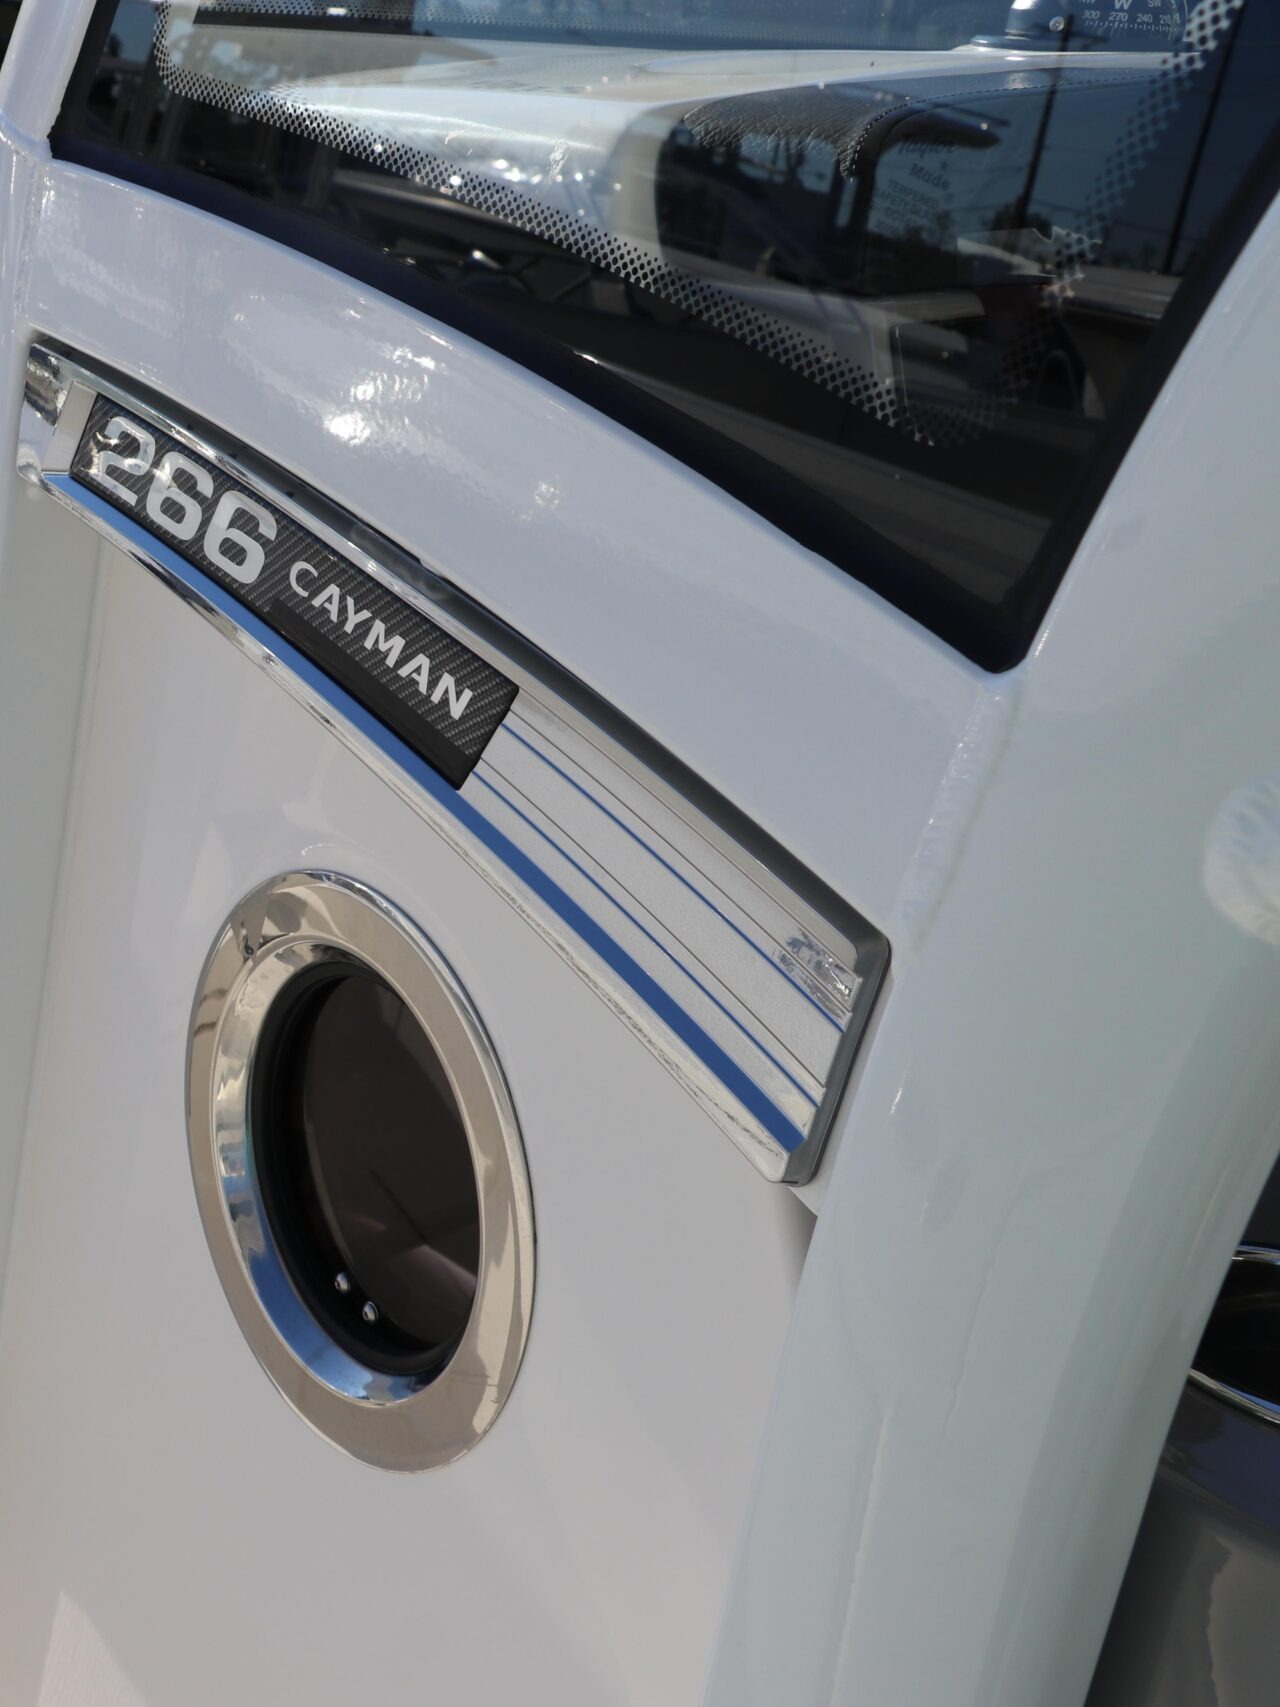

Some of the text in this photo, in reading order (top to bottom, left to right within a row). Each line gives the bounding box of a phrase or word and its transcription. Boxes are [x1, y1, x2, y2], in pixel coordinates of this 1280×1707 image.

[1082, 10, 1100, 19] 300
[1108, 11, 1128, 21] 270
[1136, 13, 1153, 23] 240
[909, 162, 951, 191] Made
[95, 415, 474, 721] 266 CAYMAN
